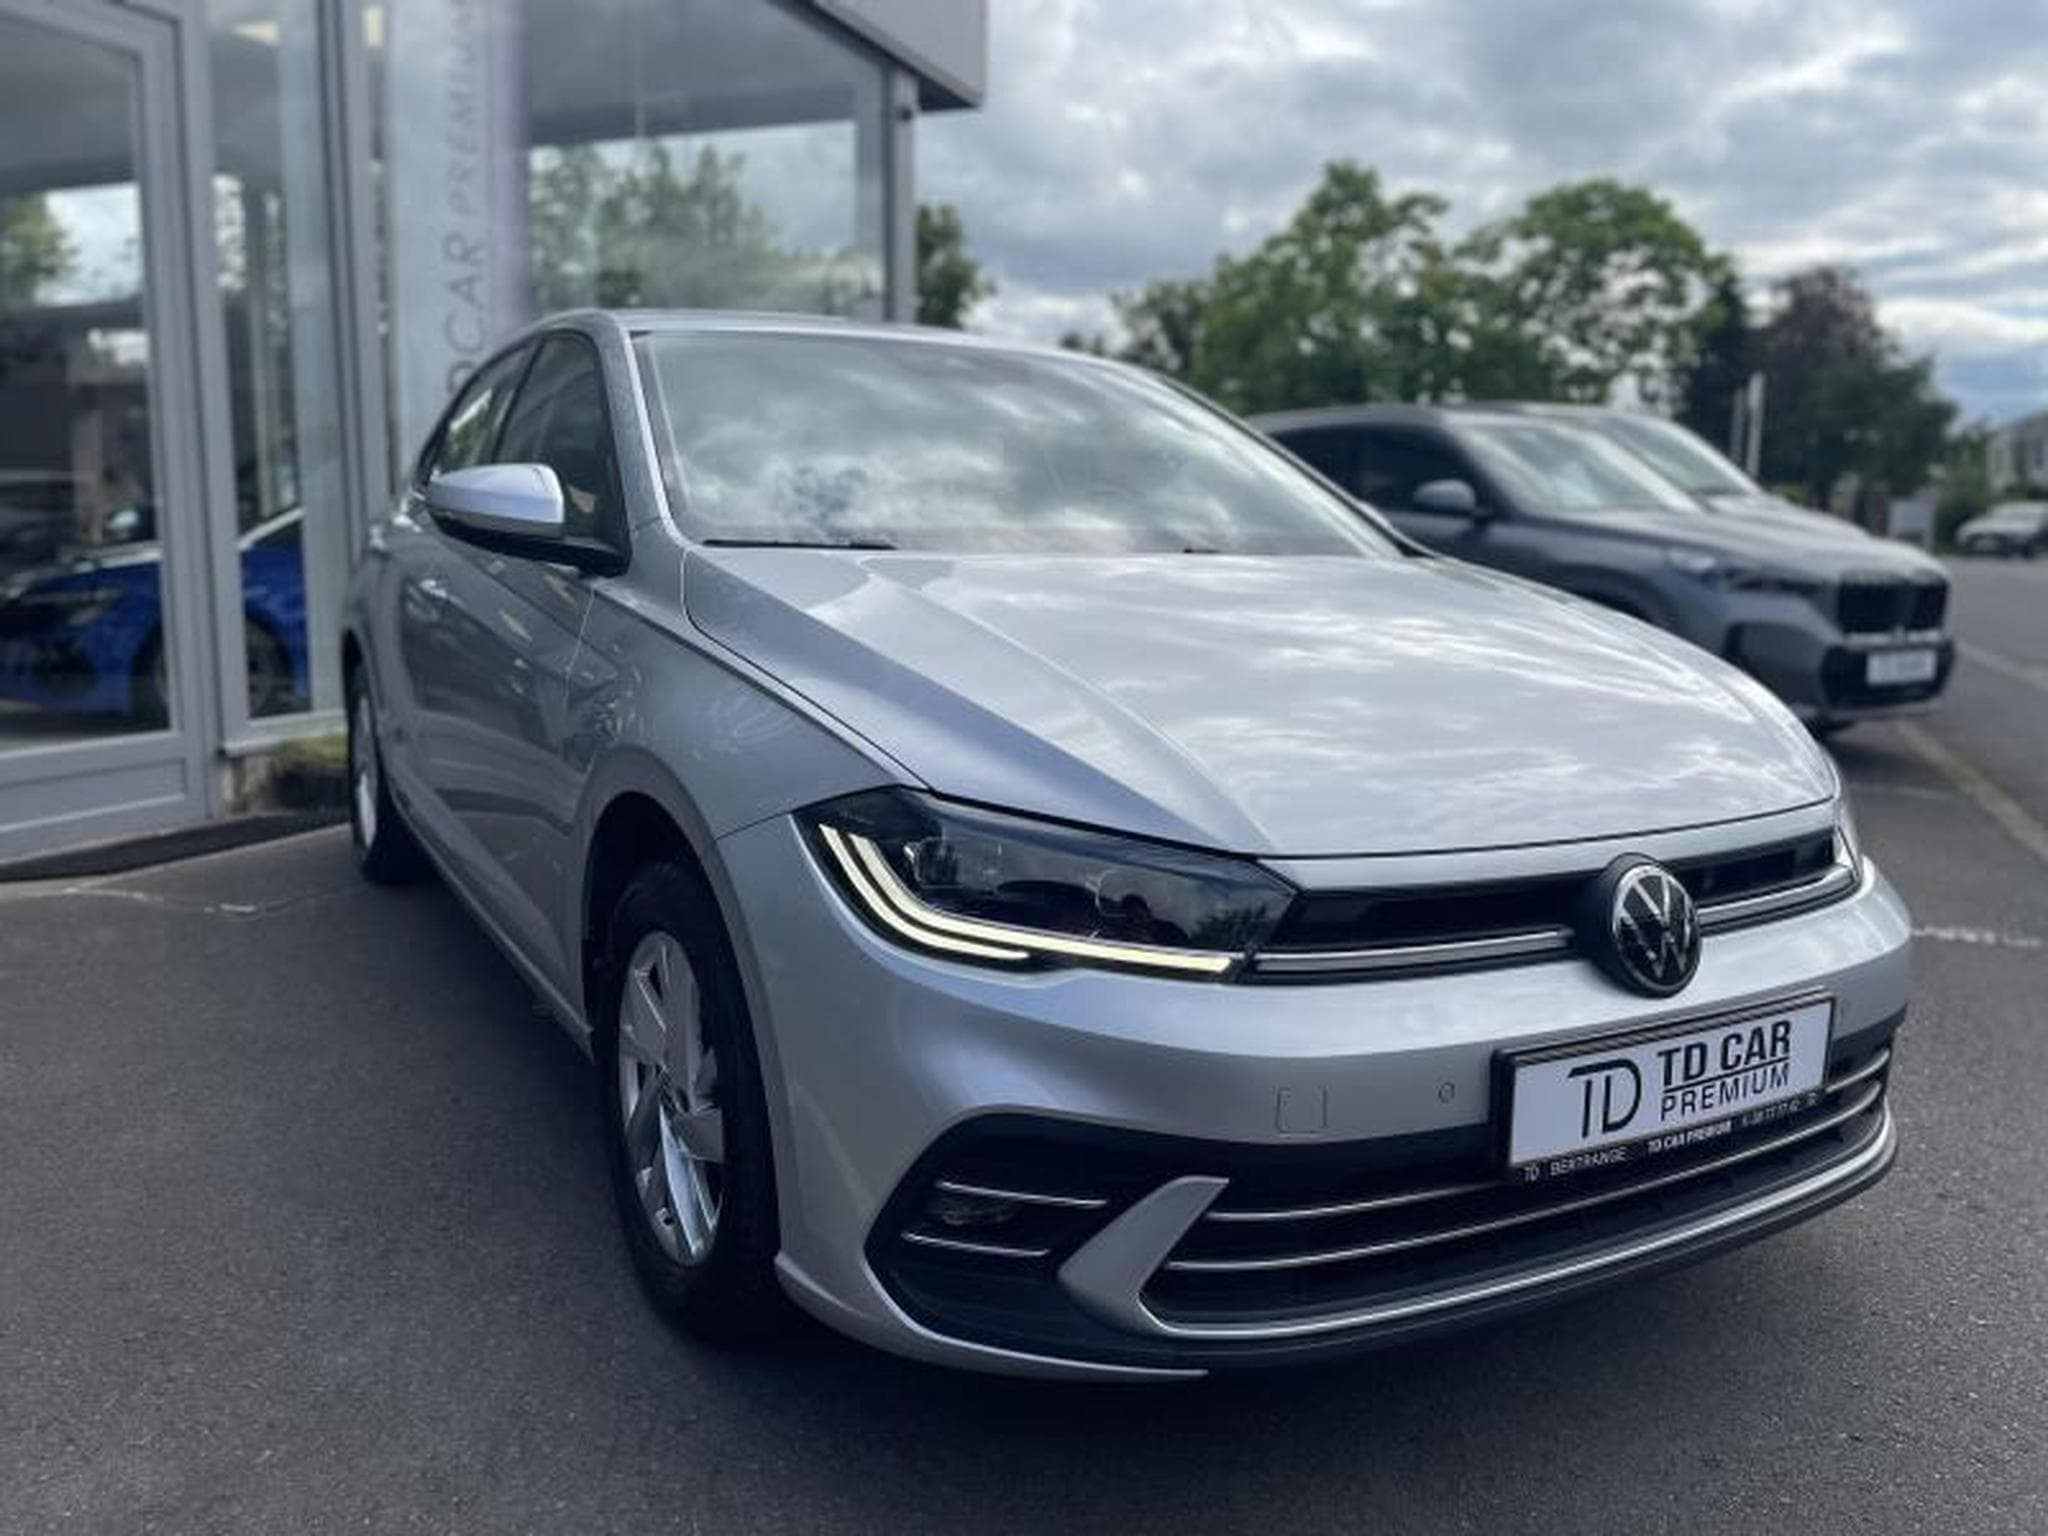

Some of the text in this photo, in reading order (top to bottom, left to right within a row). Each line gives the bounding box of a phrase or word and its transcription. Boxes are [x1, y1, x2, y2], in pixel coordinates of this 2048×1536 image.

[1657, 1019, 1792, 1087] TD CAR
[1568, 1058, 1642, 1139] TD
[1660, 1061, 1791, 1122] PREMIUM
